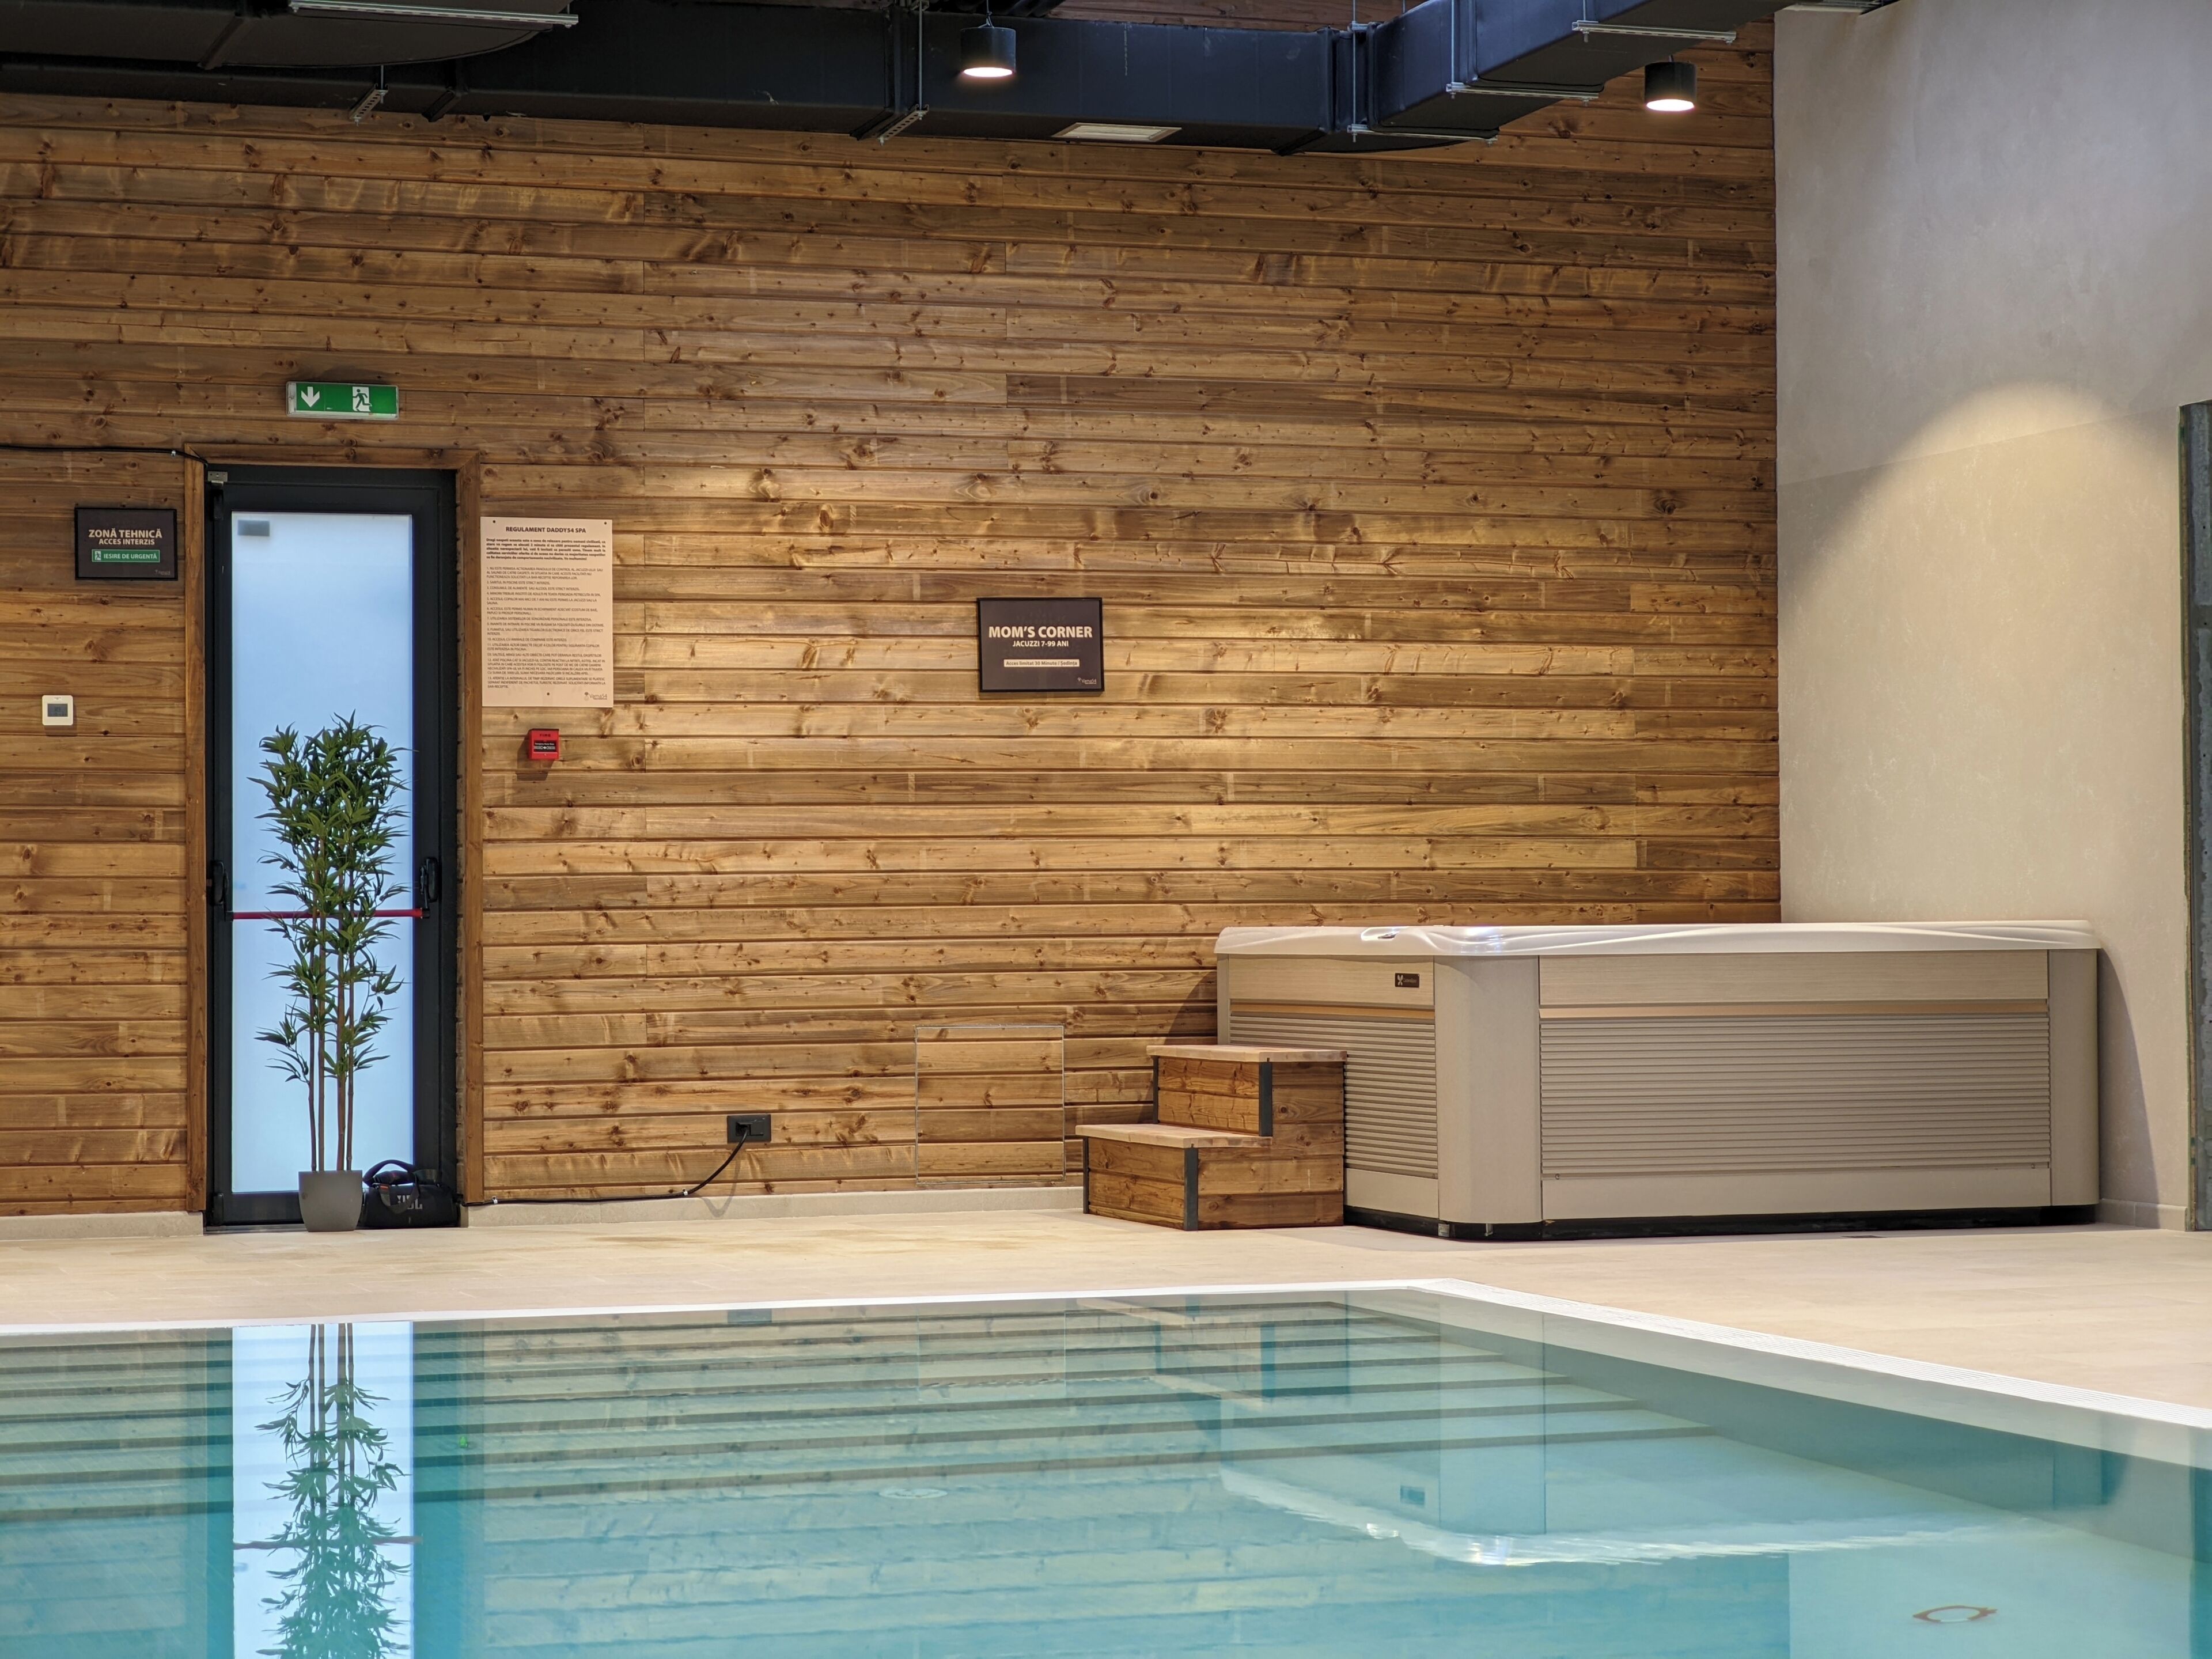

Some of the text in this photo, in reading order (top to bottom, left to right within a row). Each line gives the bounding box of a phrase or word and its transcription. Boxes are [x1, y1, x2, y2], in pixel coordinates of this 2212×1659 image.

[89, 528, 162, 538] ZONĂ TEHNICĂ
[1038, 626, 1092, 638] CORNER
